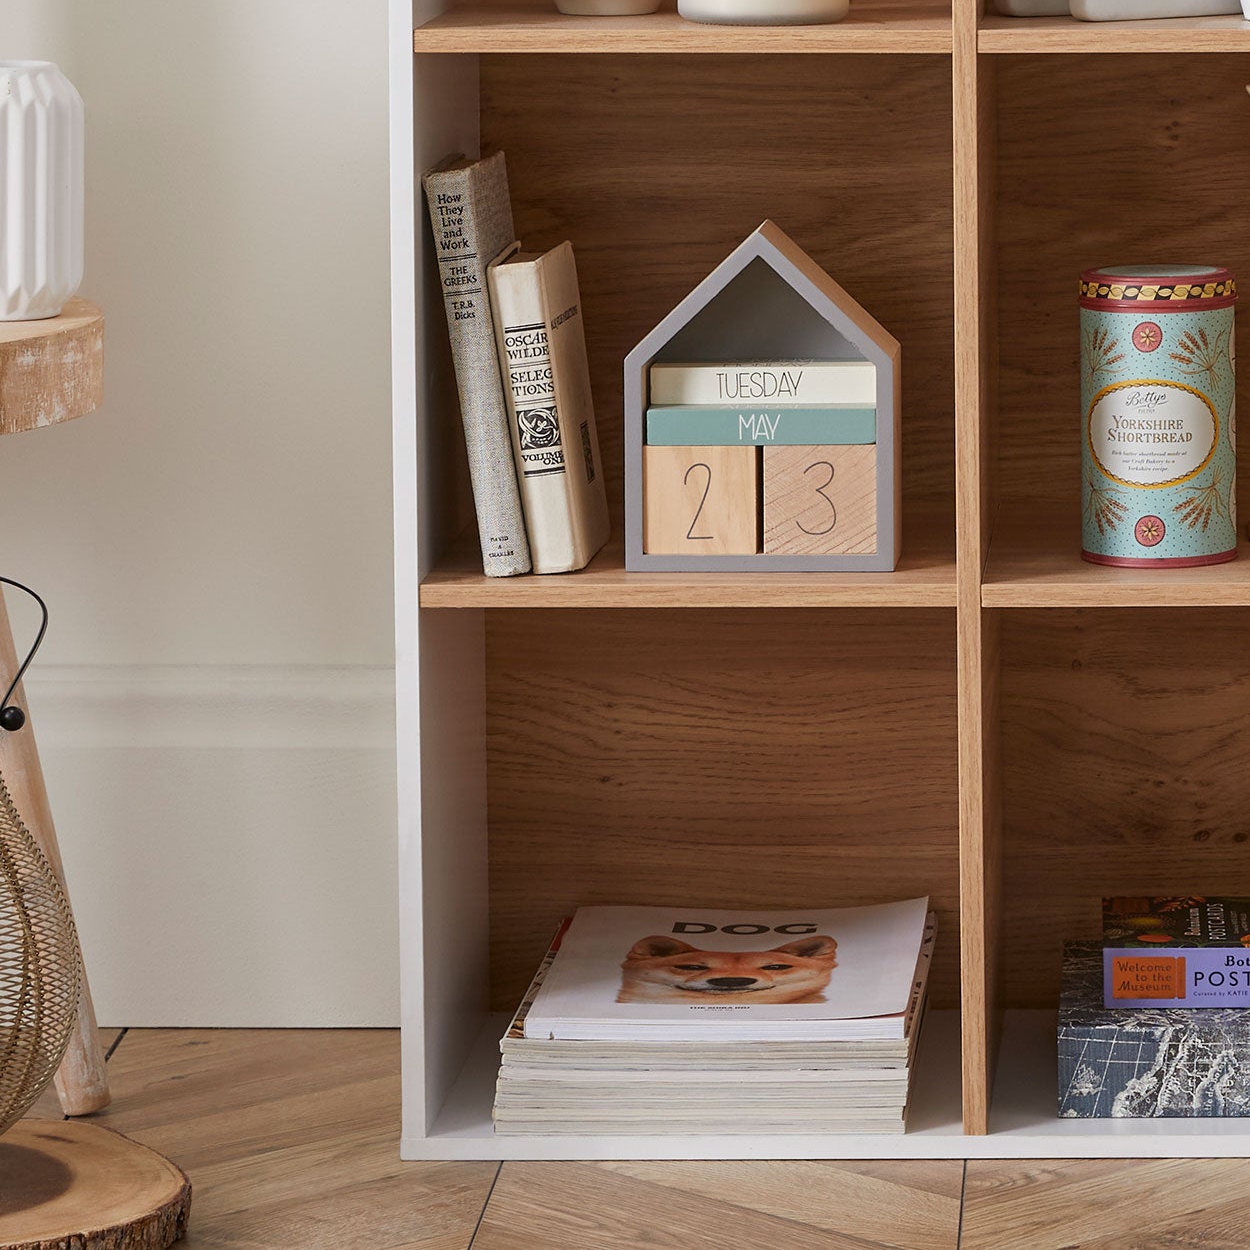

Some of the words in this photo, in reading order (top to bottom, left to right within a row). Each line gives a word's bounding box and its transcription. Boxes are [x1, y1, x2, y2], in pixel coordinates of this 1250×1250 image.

[437, 193, 462, 205] How
[437, 205, 464, 216] They
[441, 217, 463, 228] Live
[443, 227, 463, 239] and
[440, 238, 470, 251] Work
[449, 265, 468, 276] THE
[443, 274, 478, 287] GREEKS
[454, 311, 476, 321] Dicks
[505, 331, 549, 348] OSCAR
[506, 345, 551, 360] WILDE
[511, 381, 555, 397] TIONS
[716, 370, 803, 399] TUESDAY
[1125, 390, 1169, 409] Bettys
[738, 413, 781, 441] MAY
[1112, 414, 1184, 430] YORKSHIRE
[1107, 428, 1193, 444] SHORTBREAD
[521, 450, 565, 463] VOLUME
[542, 457, 566, 466] ONE
[683, 462, 715, 540] 2
[795, 460, 838, 536] 3
[671, 921, 819, 935] DOG
[1206, 903, 1227, 940] POSTCARDS
[1116, 960, 1172, 973] Welcome
[1135, 973, 1148, 982] to
[1152, 972, 1172, 982] the
[1117, 980, 1172, 992] Museum
[1218, 990, 1225, 998] by
